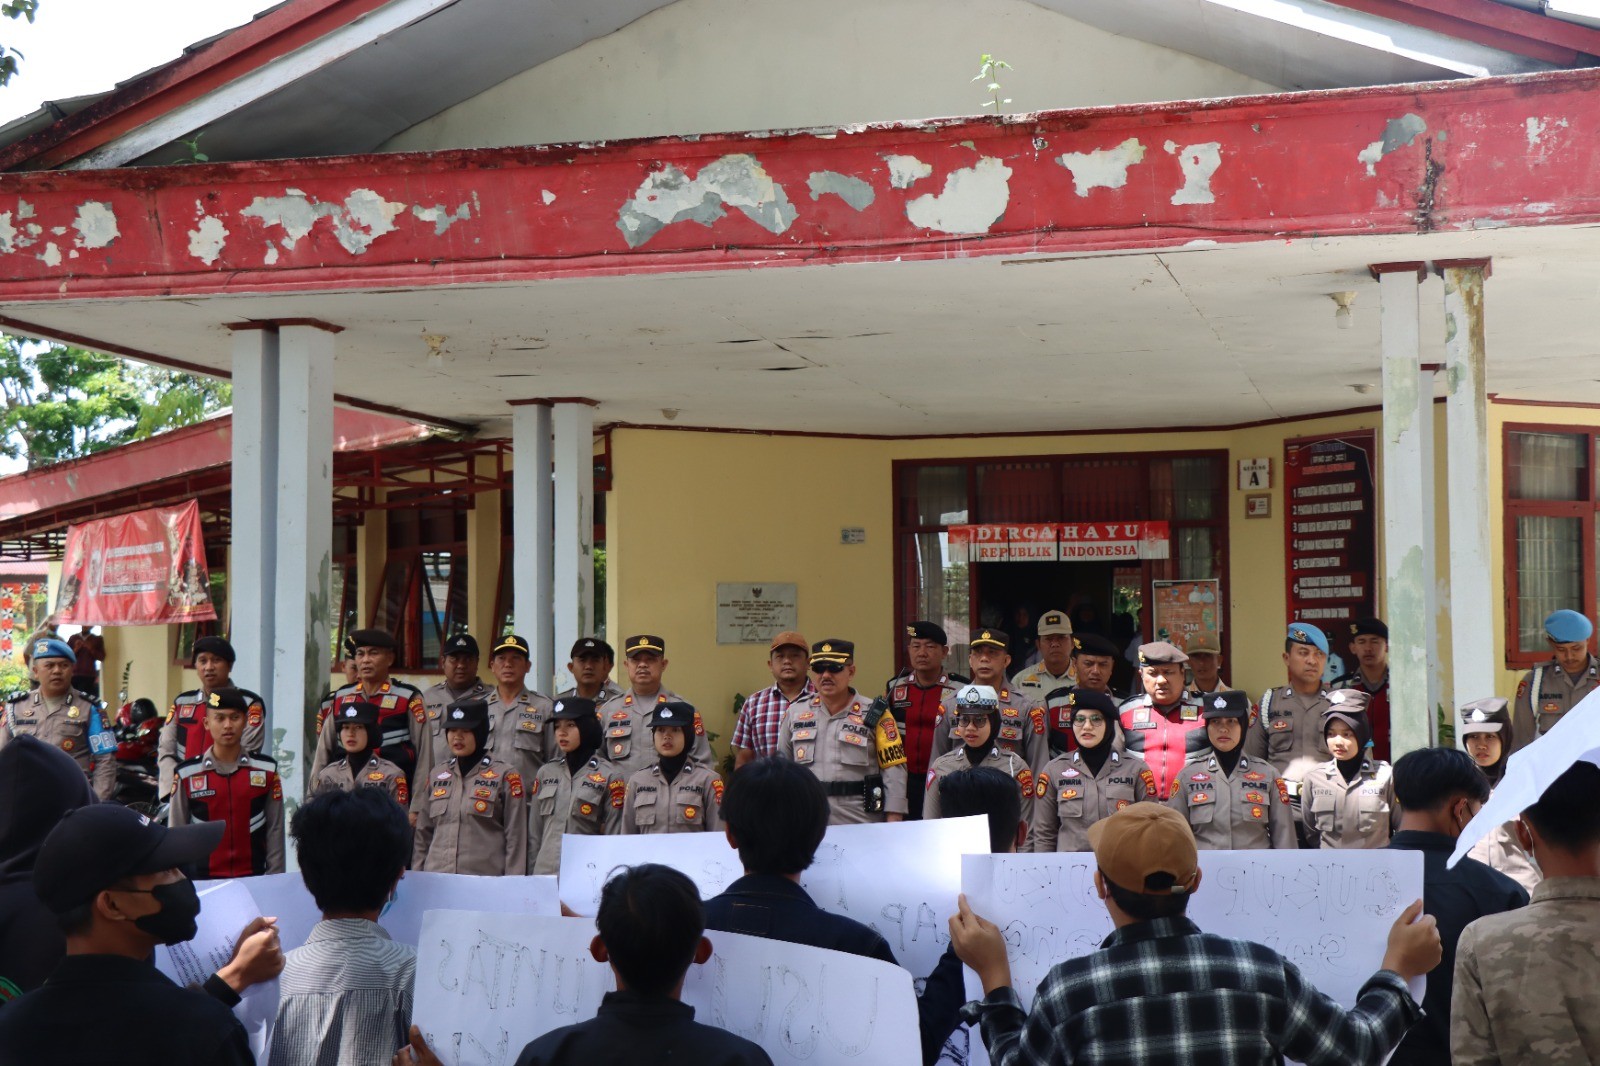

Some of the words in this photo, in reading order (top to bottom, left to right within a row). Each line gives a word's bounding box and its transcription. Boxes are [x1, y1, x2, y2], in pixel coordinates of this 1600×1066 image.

[1249, 472, 1260, 486] A
[976, 524, 1139, 540] DIRGAHAYU
[980, 546, 1053, 558] REPUBLIK
[1063, 545, 1138, 557] INDONESIA
[1292, 559, 1299, 570] 5
[519, 712, 543, 721] POLRI
[842, 723, 869, 737] POLRI
[433, 780, 452, 788] FEBI
[474, 779, 499, 789] POLRI
[1108, 777, 1134, 786] POLRI
[581, 780, 605, 793] POLRI
[678, 785, 705, 794] POLRI
[1188, 782, 1214, 791] TIYA
[1241, 782, 1268, 791] POLRI
[1361, 788, 1386, 797] POLRI
